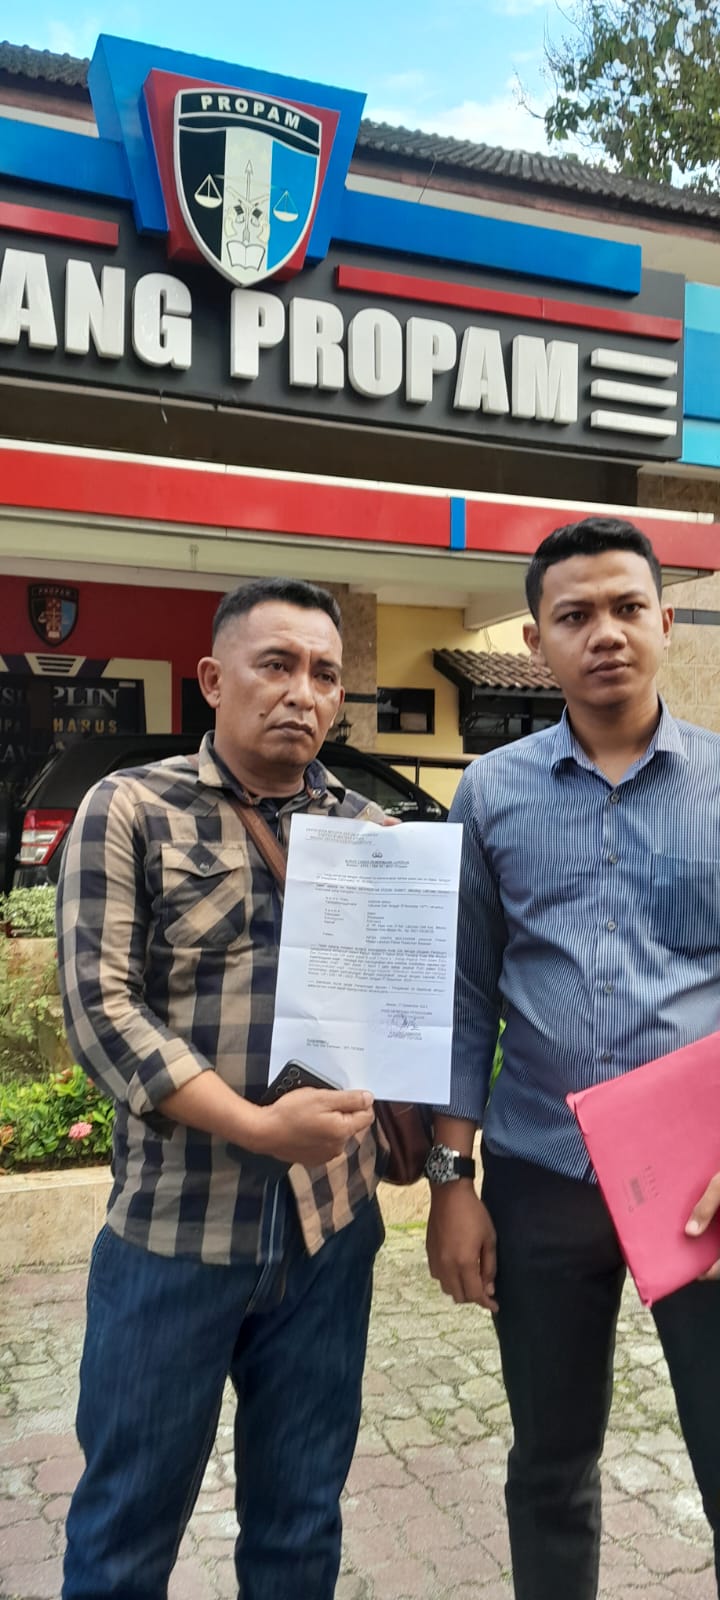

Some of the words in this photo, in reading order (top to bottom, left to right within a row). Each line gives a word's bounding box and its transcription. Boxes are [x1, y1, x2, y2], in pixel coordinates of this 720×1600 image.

[200, 94, 301, 130] PROPAM
[0, 248, 192, 370] ANG
[230, 287, 579, 425] PROPAM
[52, 716, 118, 736] HARUS
